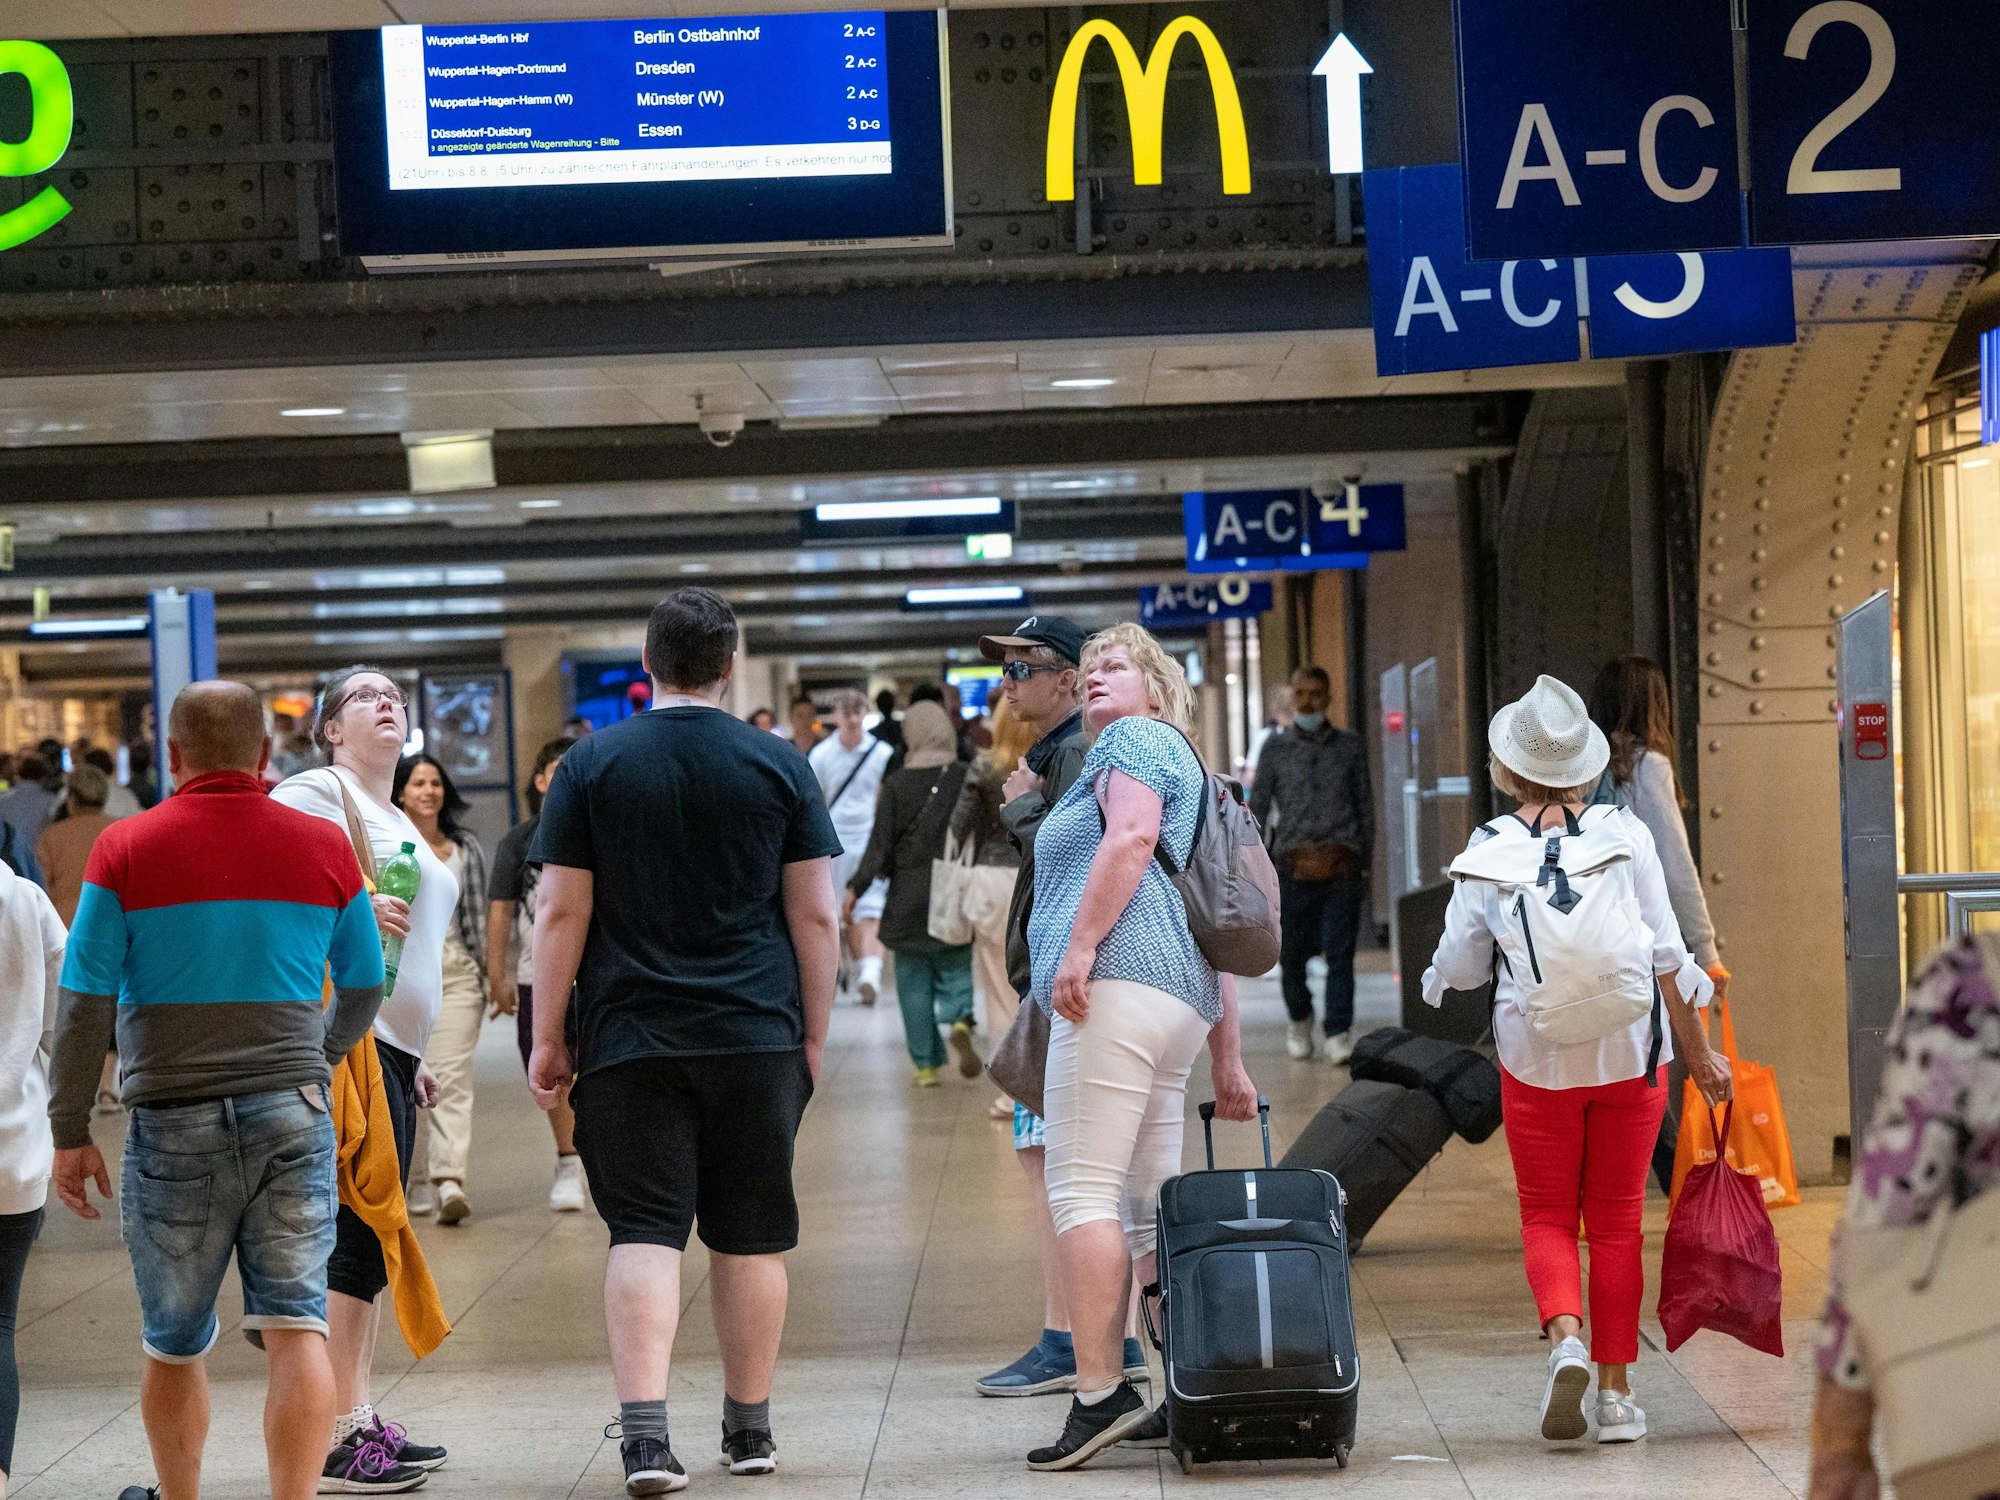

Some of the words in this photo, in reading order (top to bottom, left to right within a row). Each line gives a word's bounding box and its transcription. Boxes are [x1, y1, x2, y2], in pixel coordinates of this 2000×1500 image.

[634, 30, 674, 44] Berlin
[678, 27, 760, 43] Ostbahnhof
[844, 24, 854, 38] 2
[856, 26, 876, 37] A-C
[426, 34, 508, 47] Wuppertal-Berlin
[510, 33, 529, 44] Hbf
[635, 60, 696, 76] Dresden
[844, 55, 855, 68] 2
[858, 58, 877, 68] A-C
[428, 63, 566, 78] Wuppertal-Hagen-Dortmund
[637, 90, 694, 106] Münster
[698, 90, 724, 107] (W)
[846, 86, 856, 100] 2
[858, 89, 878, 99] A-C
[1783, 0, 1901, 194] 2
[429, 95, 552, 110] Wuppertal-Hagen-Hamm
[554, 94, 573, 106] (W)
[638, 123, 682, 138] Essen
[848, 117, 858, 130] 3
[860, 120, 880, 130] D-G
[431, 127, 532, 139] Düsseldorf-Duisburg
[437, 143, 484, 153] angezeigte
[486, 141, 529, 152] geänderte
[530, 139, 593, 150] Wagenreihung
[600, 138, 620, 146] Bitte
[1496, 95, 1718, 209] A-C
[1394, 255, 1562, 336] A-C
[1213, 501, 1296, 545] A-C
[1858, 716, 1886, 726] STOP
